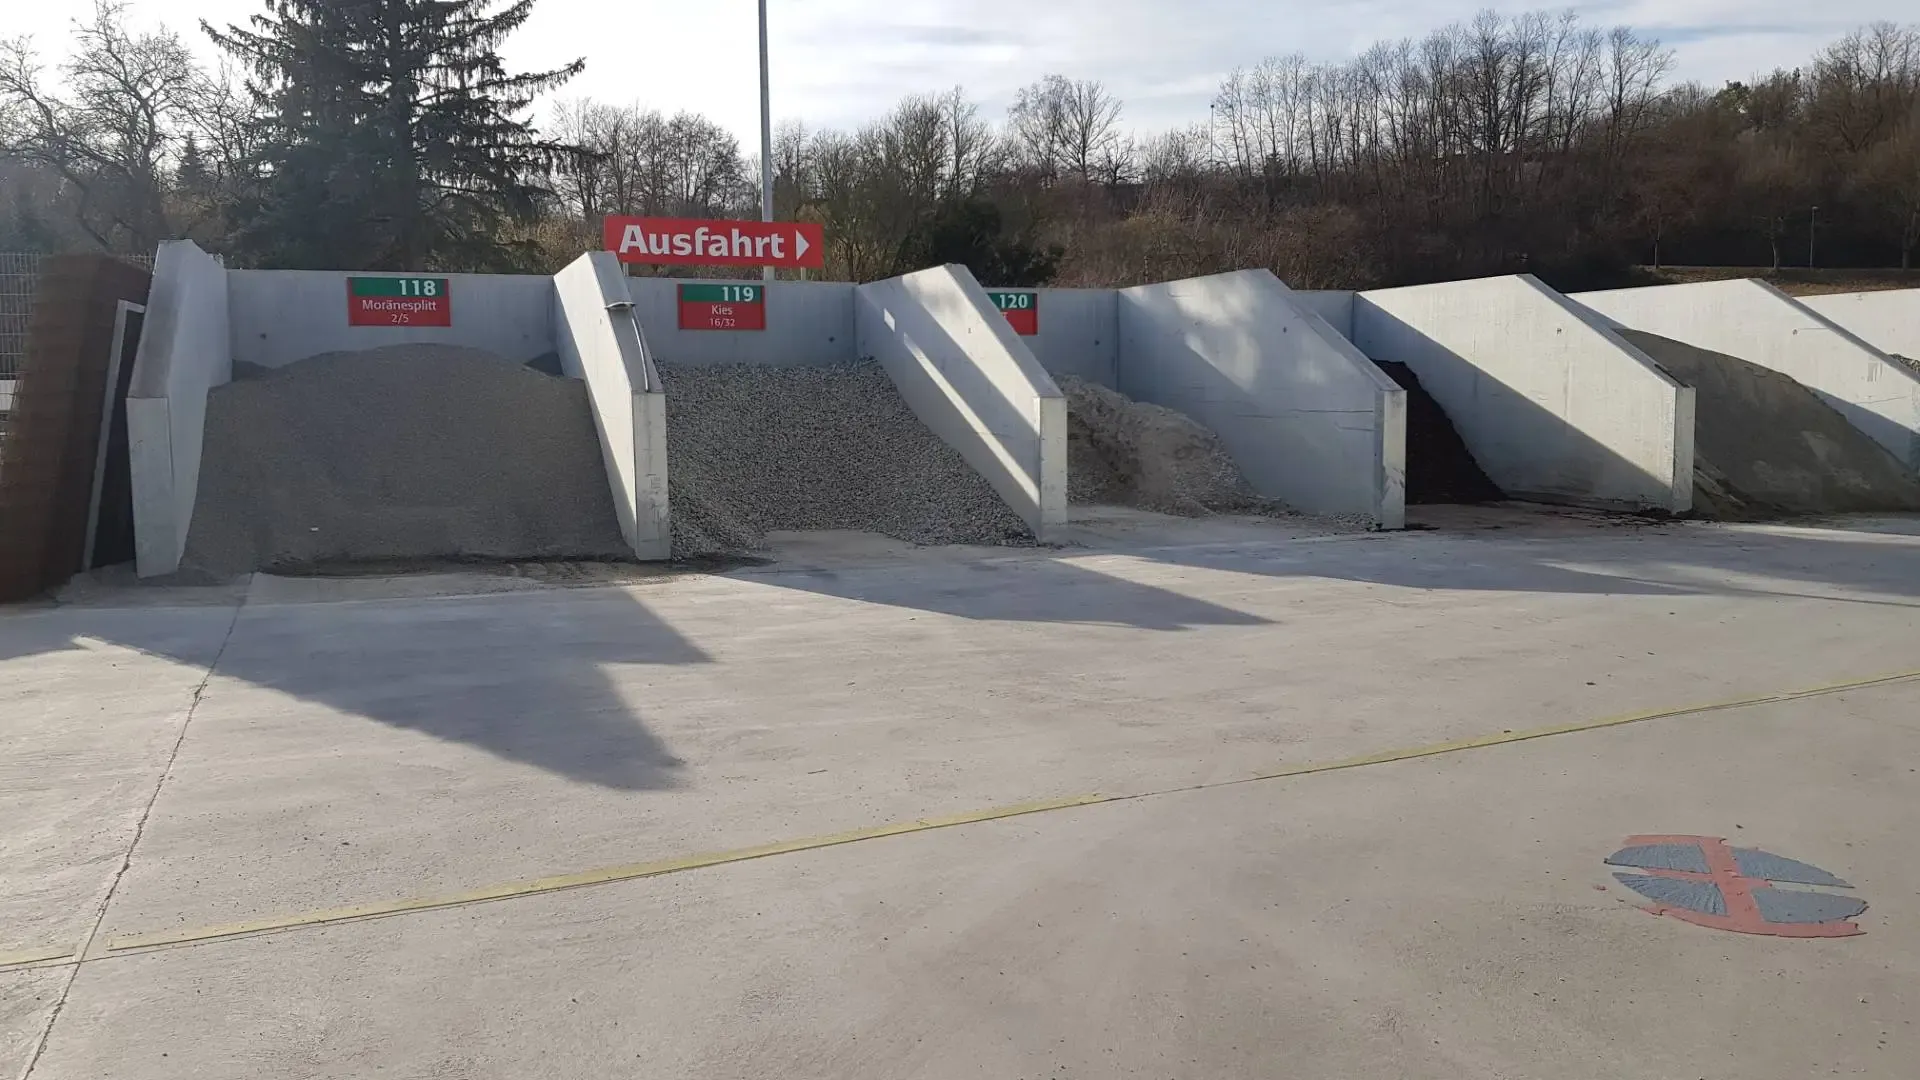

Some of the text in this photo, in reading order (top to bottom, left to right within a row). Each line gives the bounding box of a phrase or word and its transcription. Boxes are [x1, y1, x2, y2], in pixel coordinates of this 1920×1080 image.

[619, 224, 785, 259] Ausfahrt
[399, 280, 436, 296] 118
[722, 286, 754, 302] 119
[362, 300, 436, 312] Moränesplitt
[999, 294, 1028, 309] 120
[711, 304, 733, 315] Kies
[391, 313, 409, 324] 2/5
[709, 318, 735, 328] 16/32
